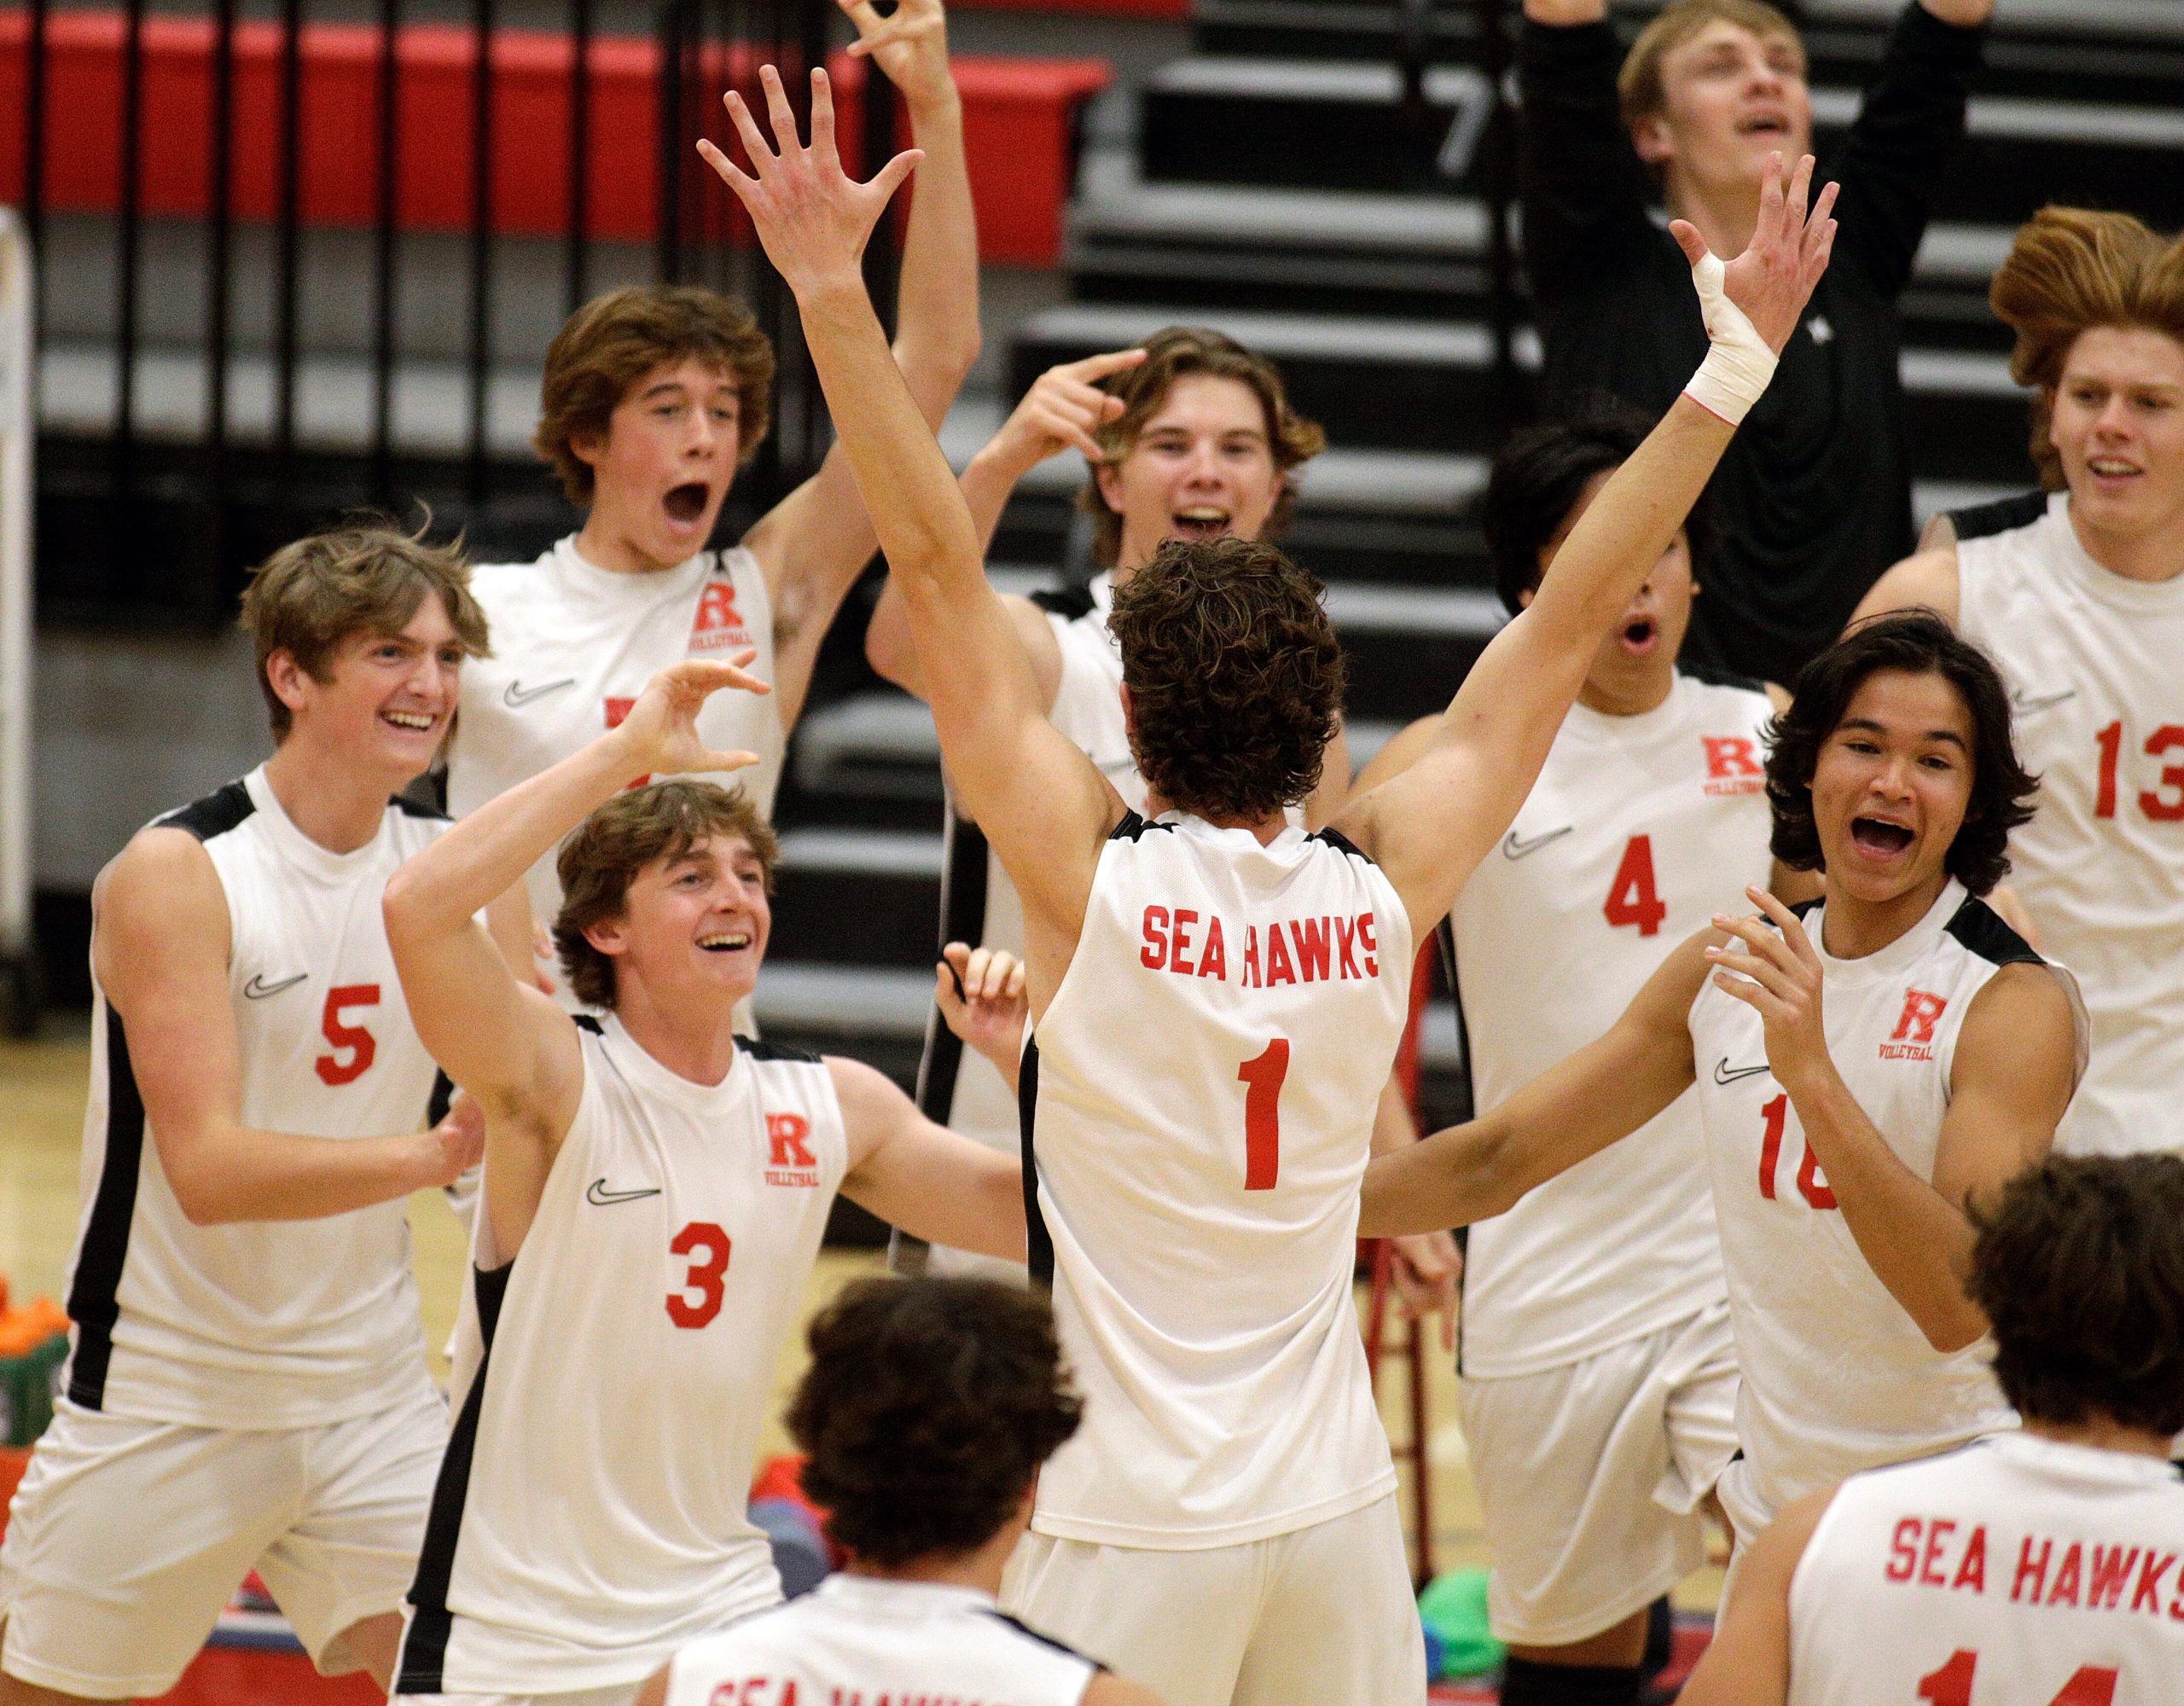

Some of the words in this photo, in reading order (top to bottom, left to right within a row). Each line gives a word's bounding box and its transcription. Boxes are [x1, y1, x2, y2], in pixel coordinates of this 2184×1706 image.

[1420, 65, 1493, 177] 7
[694, 582, 745, 631] R
[1701, 736, 1765, 778] R
[2094, 719, 2184, 824] 13
[1602, 833, 1669, 938] 4
[1140, 904, 1227, 982] SEA
[1241, 912, 1380, 989] HAWKS
[314, 982, 382, 1088] 5
[1890, 987, 1949, 1043] R
[764, 1112, 817, 1167] R
[1236, 1037, 1291, 1192] 1
[665, 1221, 733, 1331] 3
[1885, 1516, 1988, 1594] SEA
